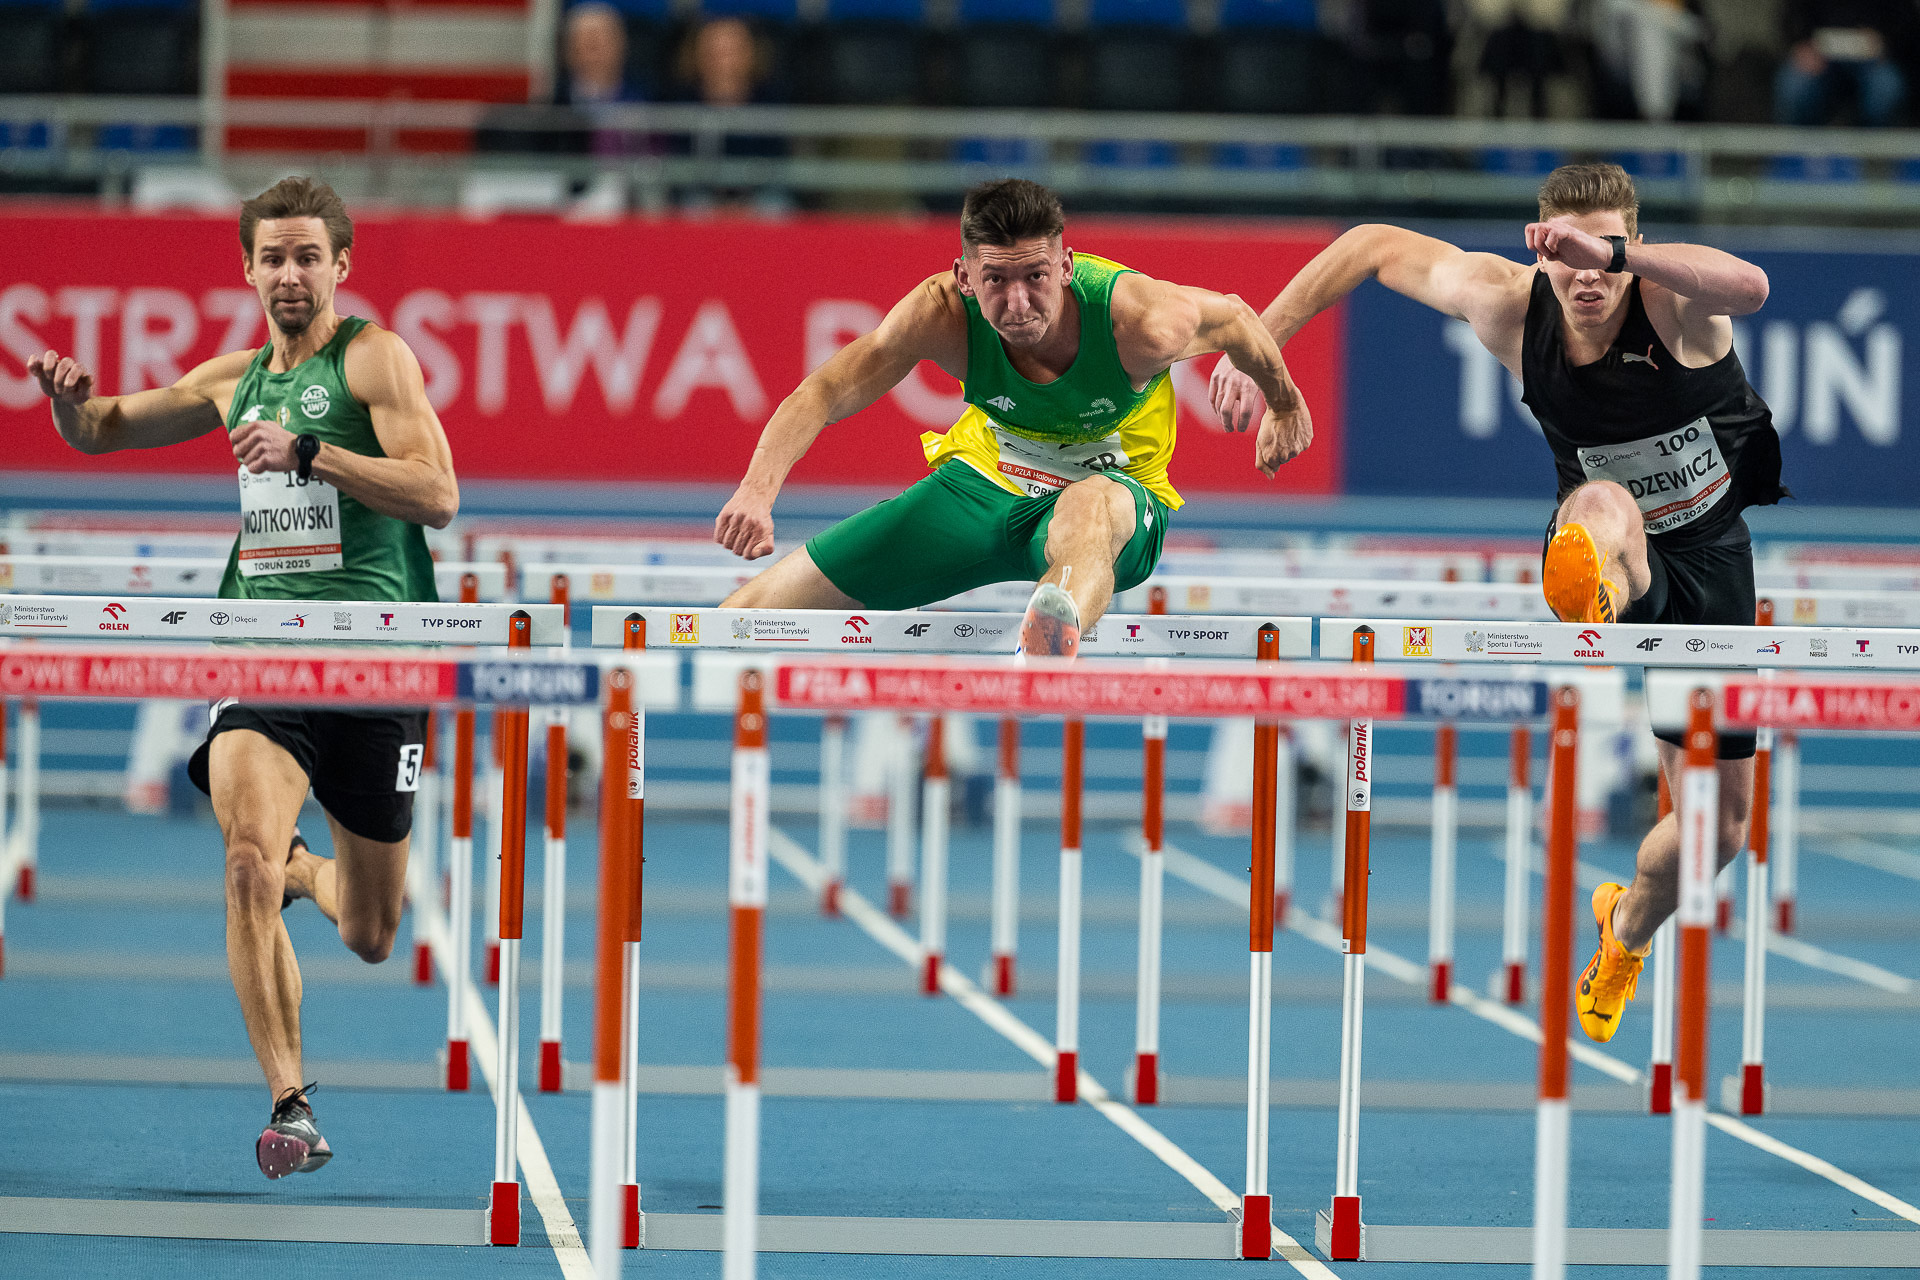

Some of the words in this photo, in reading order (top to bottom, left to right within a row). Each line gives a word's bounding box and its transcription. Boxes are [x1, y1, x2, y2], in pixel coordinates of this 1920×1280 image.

[1444, 290, 1902, 446] TUŃ
[1654, 426, 1700, 457] 100
[1002, 463, 1014, 474] 69.
[1014, 466, 1032, 478] PZLA
[1032, 471, 1058, 486] Halowe
[1617, 447, 1718, 500] DZEWICZ
[1682, 500, 1709, 521] 2025
[254, 558, 283, 571] TORUŃ
[285, 558, 311, 569] 2025
[14, 605, 55, 613] Ministerstwo
[14, 613, 35, 621] Sportu
[40, 613, 69, 621] Turystyki
[161, 611, 187, 624] 4F
[99, 623, 129, 631] ORLEN
[421, 618, 444, 628] TVP
[446, 619, 482, 629] SPORT
[754, 619, 796, 627] Ministerstwo
[754, 628, 776, 636] Sportu
[904, 623, 931, 637] 4F
[978, 627, 1003, 636] Okęcie
[1168, 629, 1191, 639] TVP
[1193, 630, 1229, 640] SPORT
[841, 636, 872, 644] ORLEN
[1487, 641, 1509, 649] Sportu
[1513, 641, 1543, 649] Turystyki
[1636, 637, 1663, 651] 4F
[1710, 643, 1734, 651] Okęcie
[1896, 645, 1919, 655] TVP
[1573, 649, 1604, 658] ORLEN
[627, 711, 641, 771] polanik
[1353, 721, 1368, 782] polanik
[405, 749, 419, 787] 5
